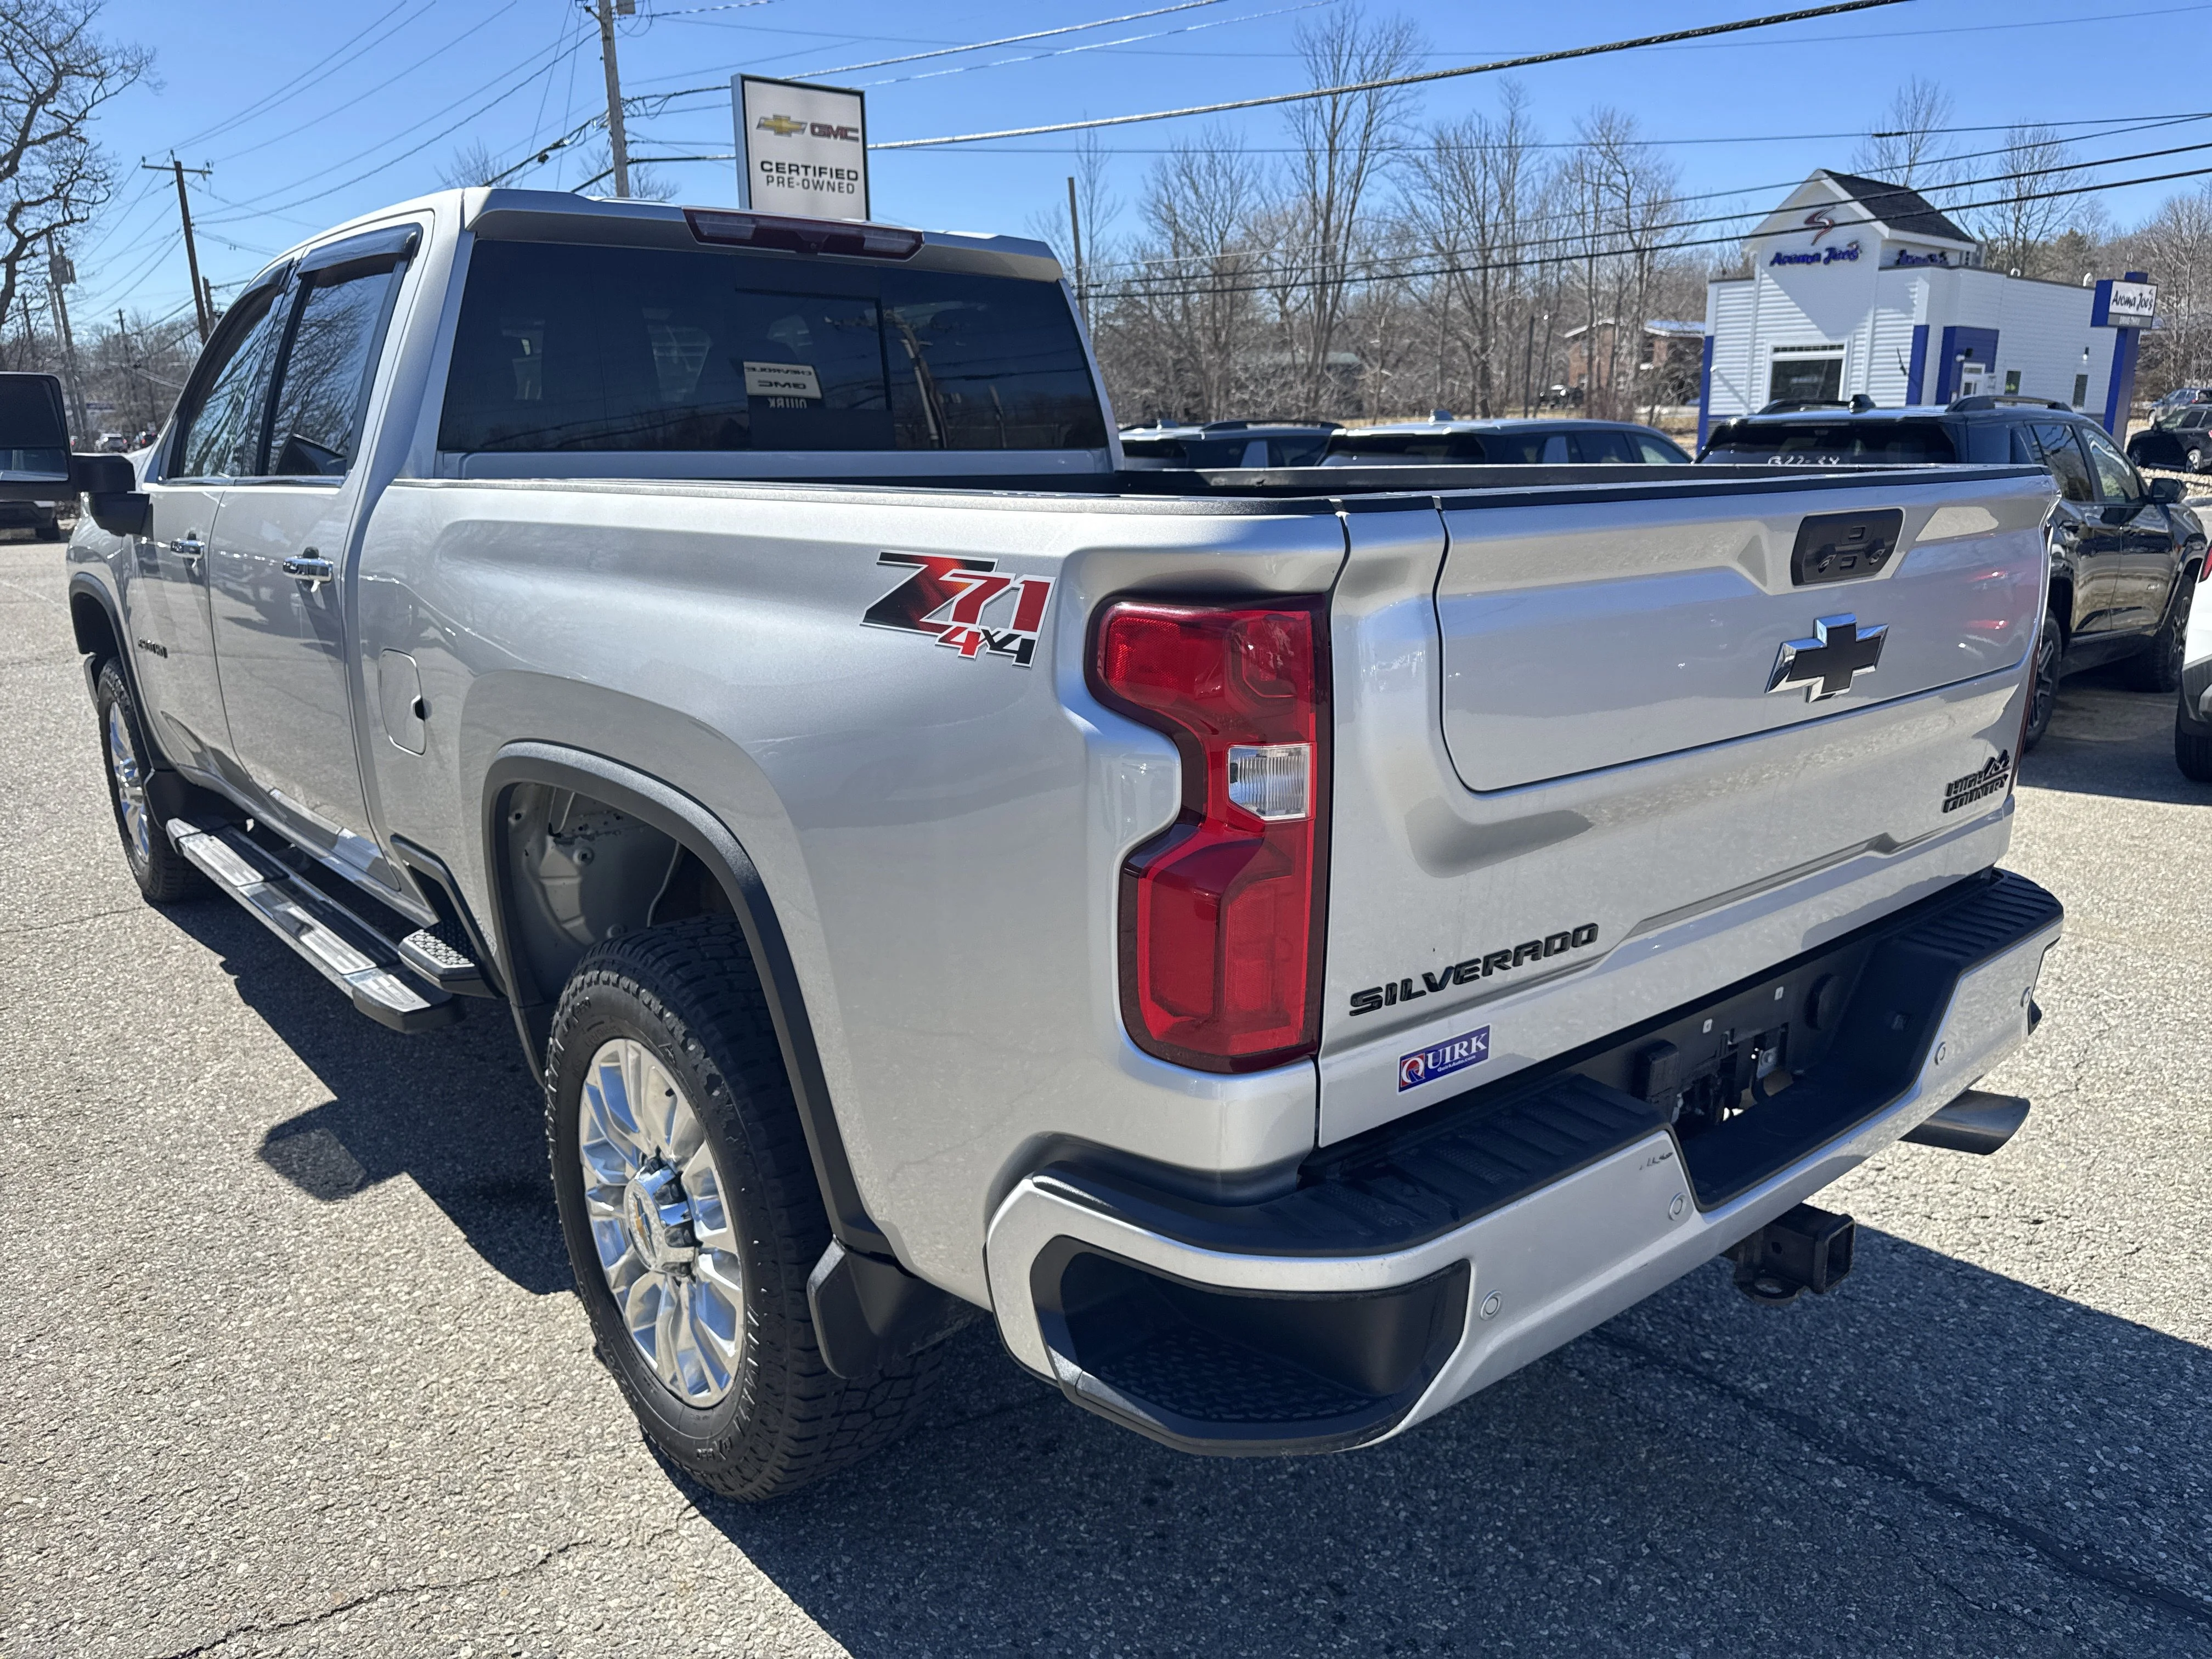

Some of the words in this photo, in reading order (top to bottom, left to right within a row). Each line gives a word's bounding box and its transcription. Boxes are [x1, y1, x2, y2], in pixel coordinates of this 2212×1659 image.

[810, 122, 859, 143] GMC
[760, 161, 858, 182] CERTIFIED
[766, 175, 855, 194] PRE-OWNED
[1769, 252, 1821, 267] Aroma
[2112, 290, 2136, 308] Aroma
[860, 550, 1056, 636] Z71
[1942, 774, 2009, 814] COUNTRY
[1944, 770, 1985, 797] HIGH
[1349, 922, 1599, 1017] SILVERADO
[1402, 1032, 1487, 1083] QUIRK
